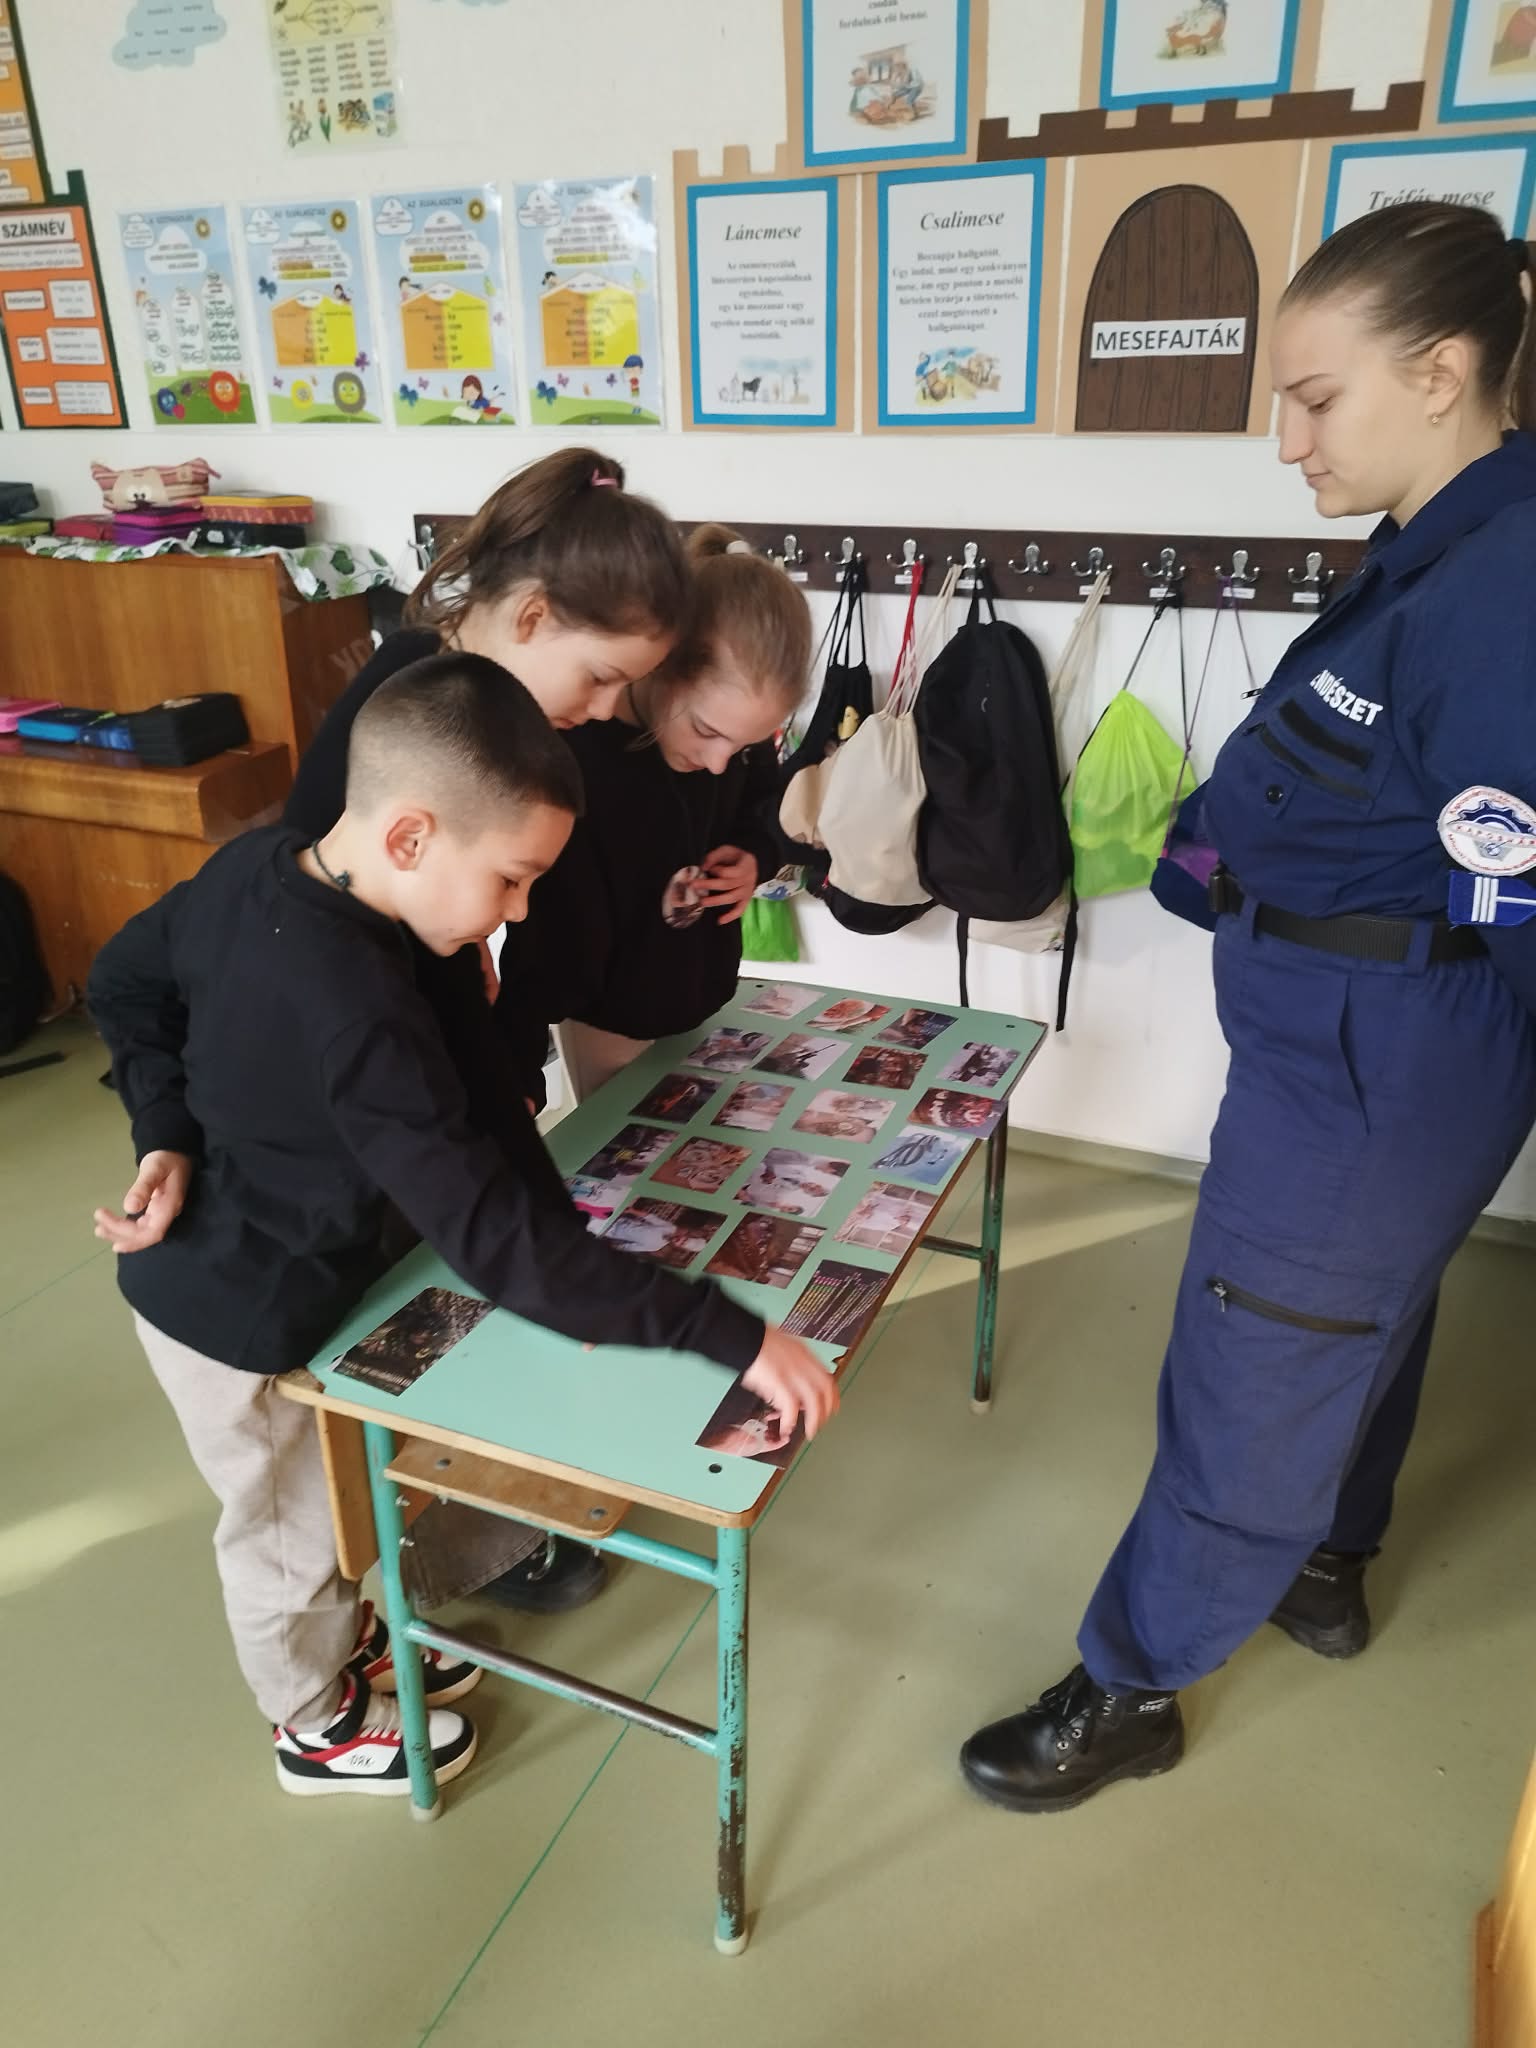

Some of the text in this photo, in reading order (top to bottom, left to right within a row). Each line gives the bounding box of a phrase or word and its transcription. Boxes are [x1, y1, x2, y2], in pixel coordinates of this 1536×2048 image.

[1441, 191, 1495, 206] mese
[1, 220, 66, 239] SZÁMNÉV
[920, 210, 1005, 231] Csalimese
[724, 224, 802, 241] Láncmese
[1096, 322, 1241, 351] MESEFAJTÁK
